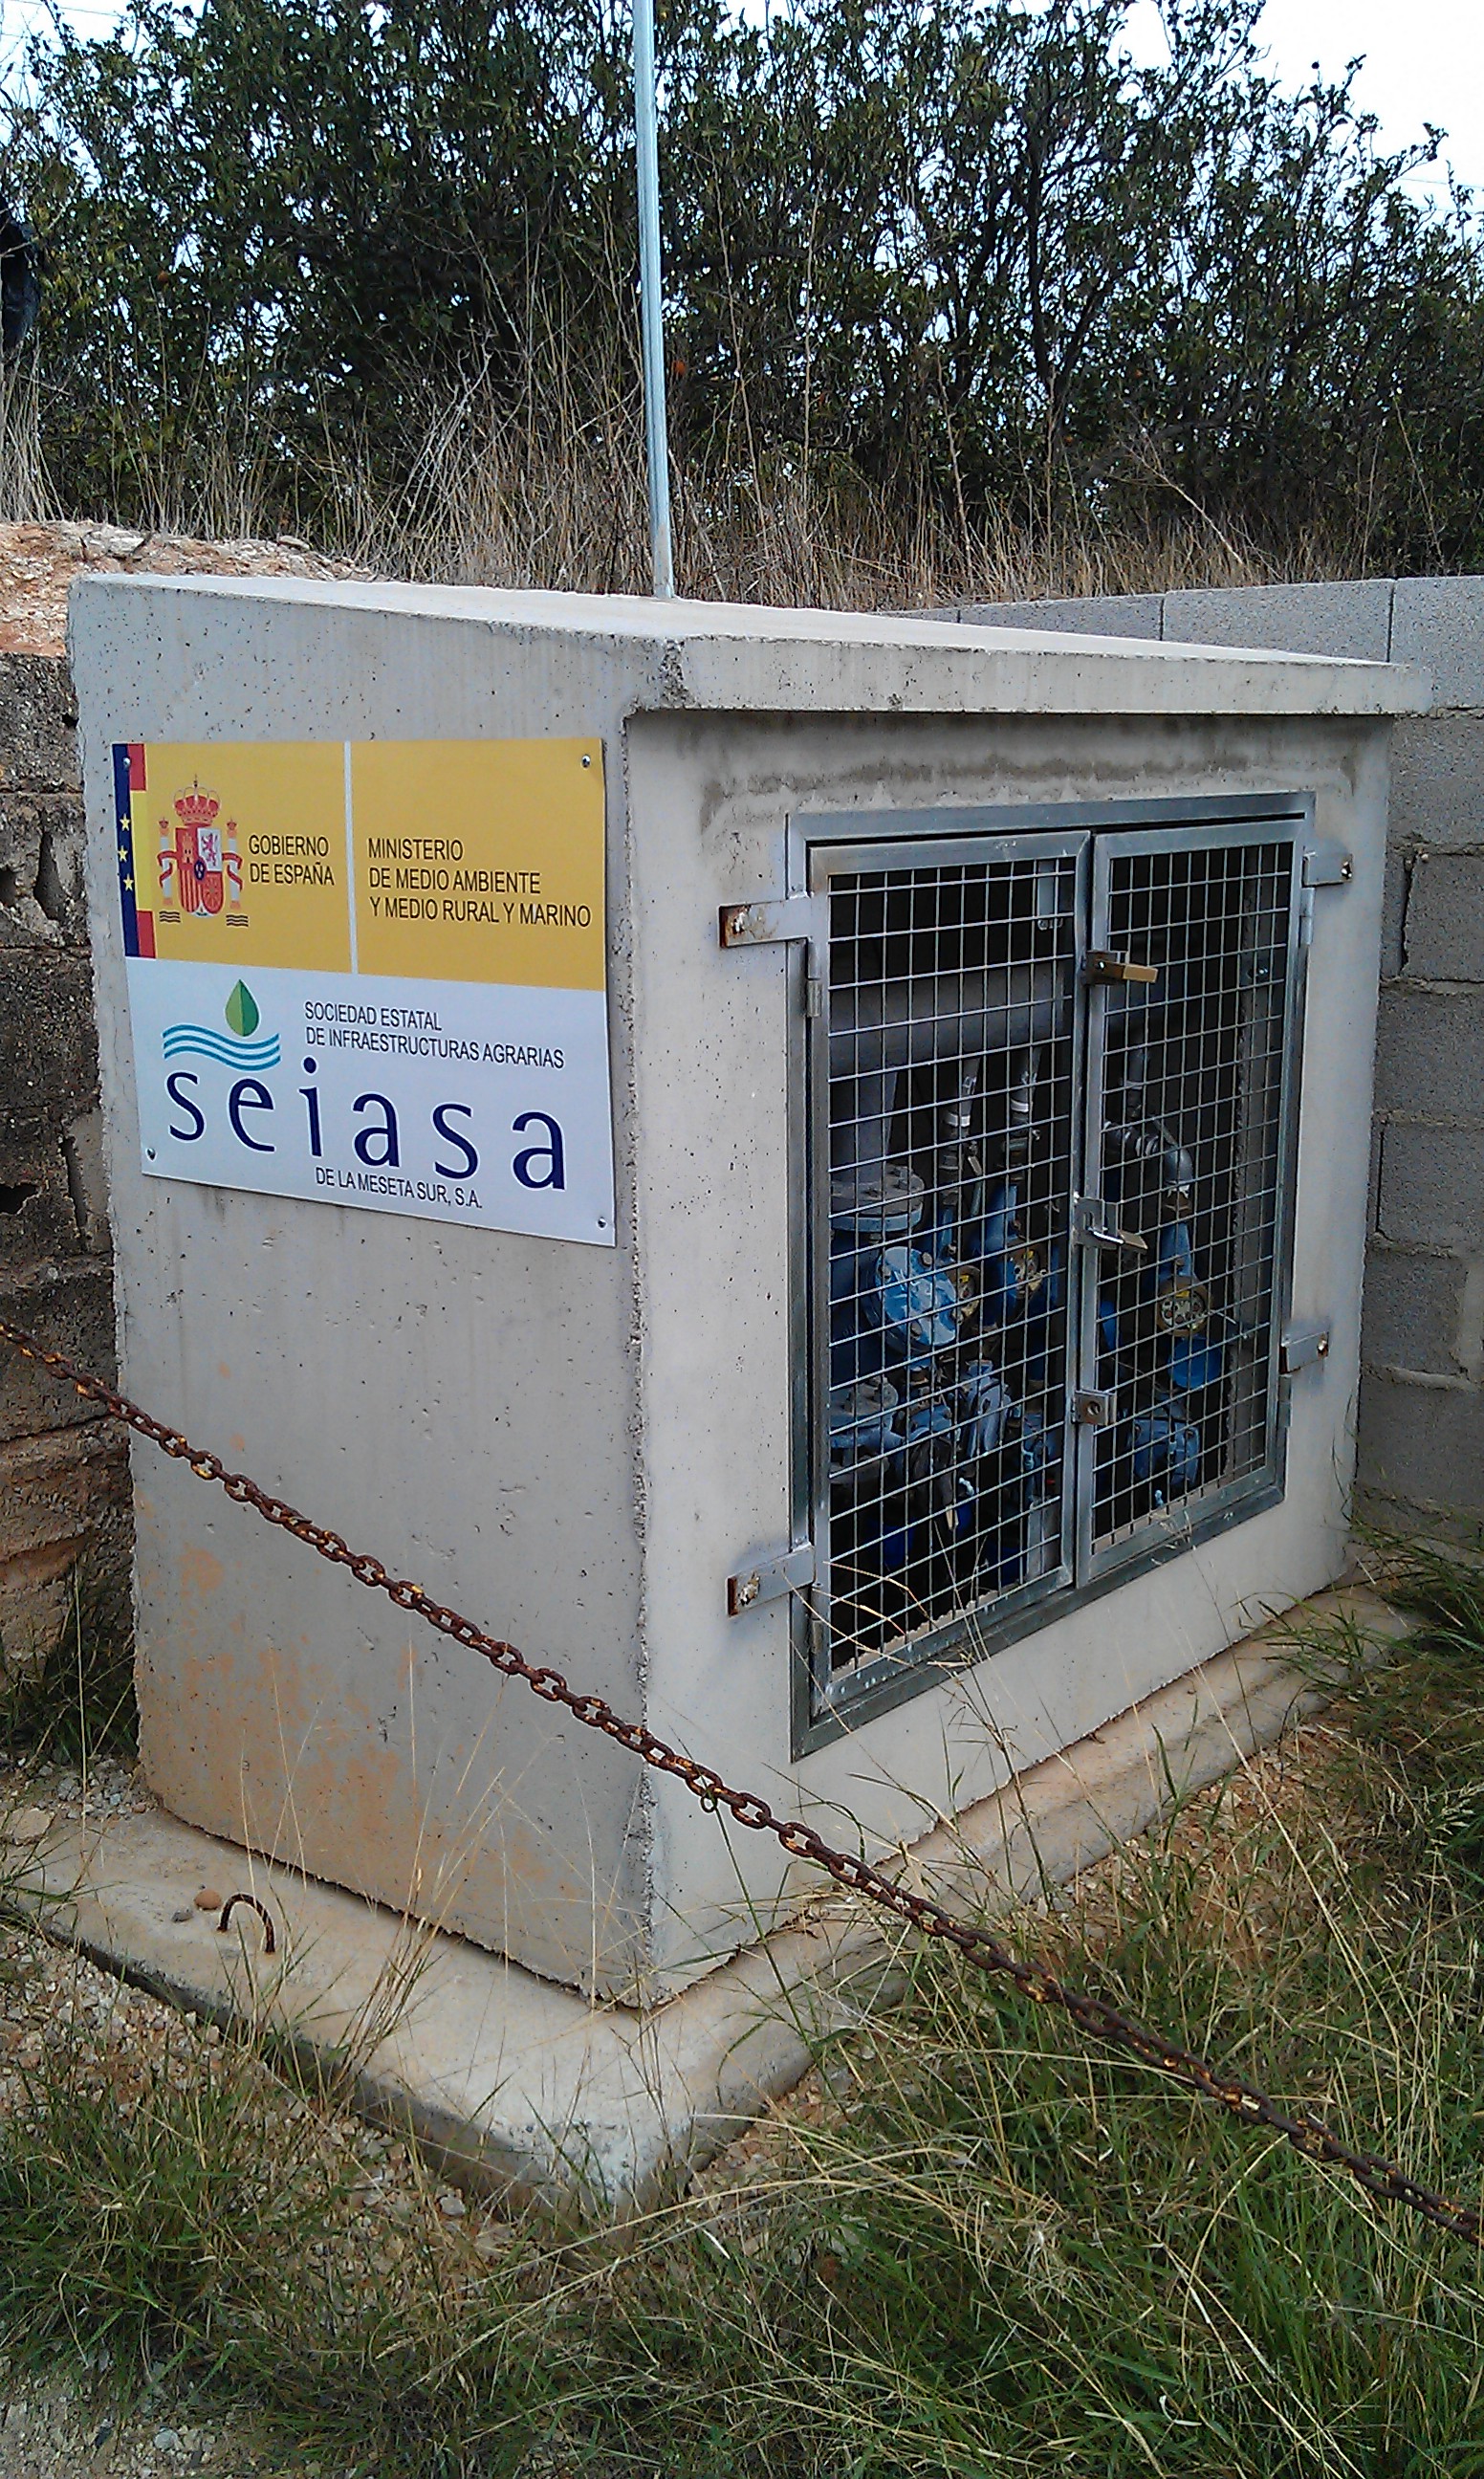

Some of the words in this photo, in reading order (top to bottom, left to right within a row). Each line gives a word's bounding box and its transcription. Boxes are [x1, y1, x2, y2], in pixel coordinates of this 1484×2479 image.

[249, 834, 329, 857] GOBIERNO
[368, 838, 463, 861] MINISTERIO
[250, 863, 271, 884] DE
[274, 861, 335, 887] ESPAÑA
[369, 867, 390, 888] DE
[396, 868, 449, 890] MEDIO
[452, 870, 540, 894] AMBIENTE
[369, 897, 382, 917] Y
[385, 898, 438, 920] MEDIO
[444, 900, 499, 923] RURAL
[502, 903, 515, 923] Y
[519, 904, 591, 928] MARINO
[304, 1001, 376, 1024] SOCIEDAD
[381, 1006, 442, 1031] ESTATAL
[306, 1026, 325, 1046] DE
[329, 1030, 479, 1061] INFRAESTRUCTURAS
[482, 1042, 564, 1068] AGRARIAS
[165, 1056, 565, 1190] seiasa
[316, 1167, 336, 1186] DE
[338, 1170, 357, 1190] LA
[359, 1173, 415, 1199] MESETA
[417, 1180, 451, 1207] SUR,
[454, 1188, 482, 1208] S.A.
